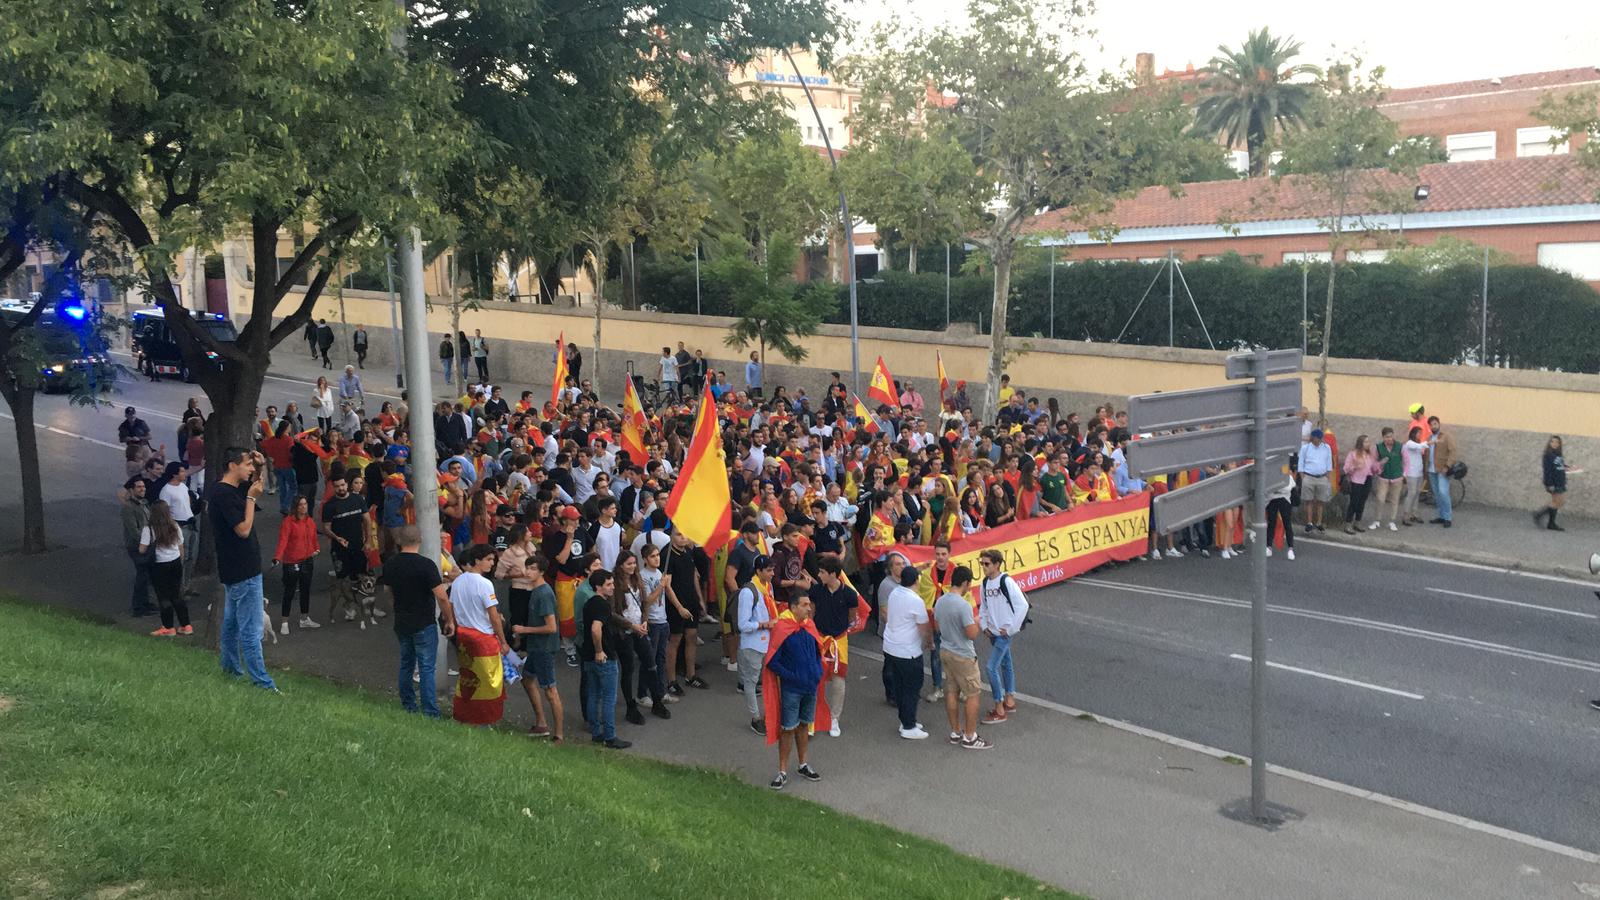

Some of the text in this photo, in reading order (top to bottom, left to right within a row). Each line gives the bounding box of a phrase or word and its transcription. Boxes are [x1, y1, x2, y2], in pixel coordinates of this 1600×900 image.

[1035, 534, 1060, 562] ÉS
[1068, 514, 1148, 553] ESPANYA
[1017, 565, 1064, 589] os de Artós
